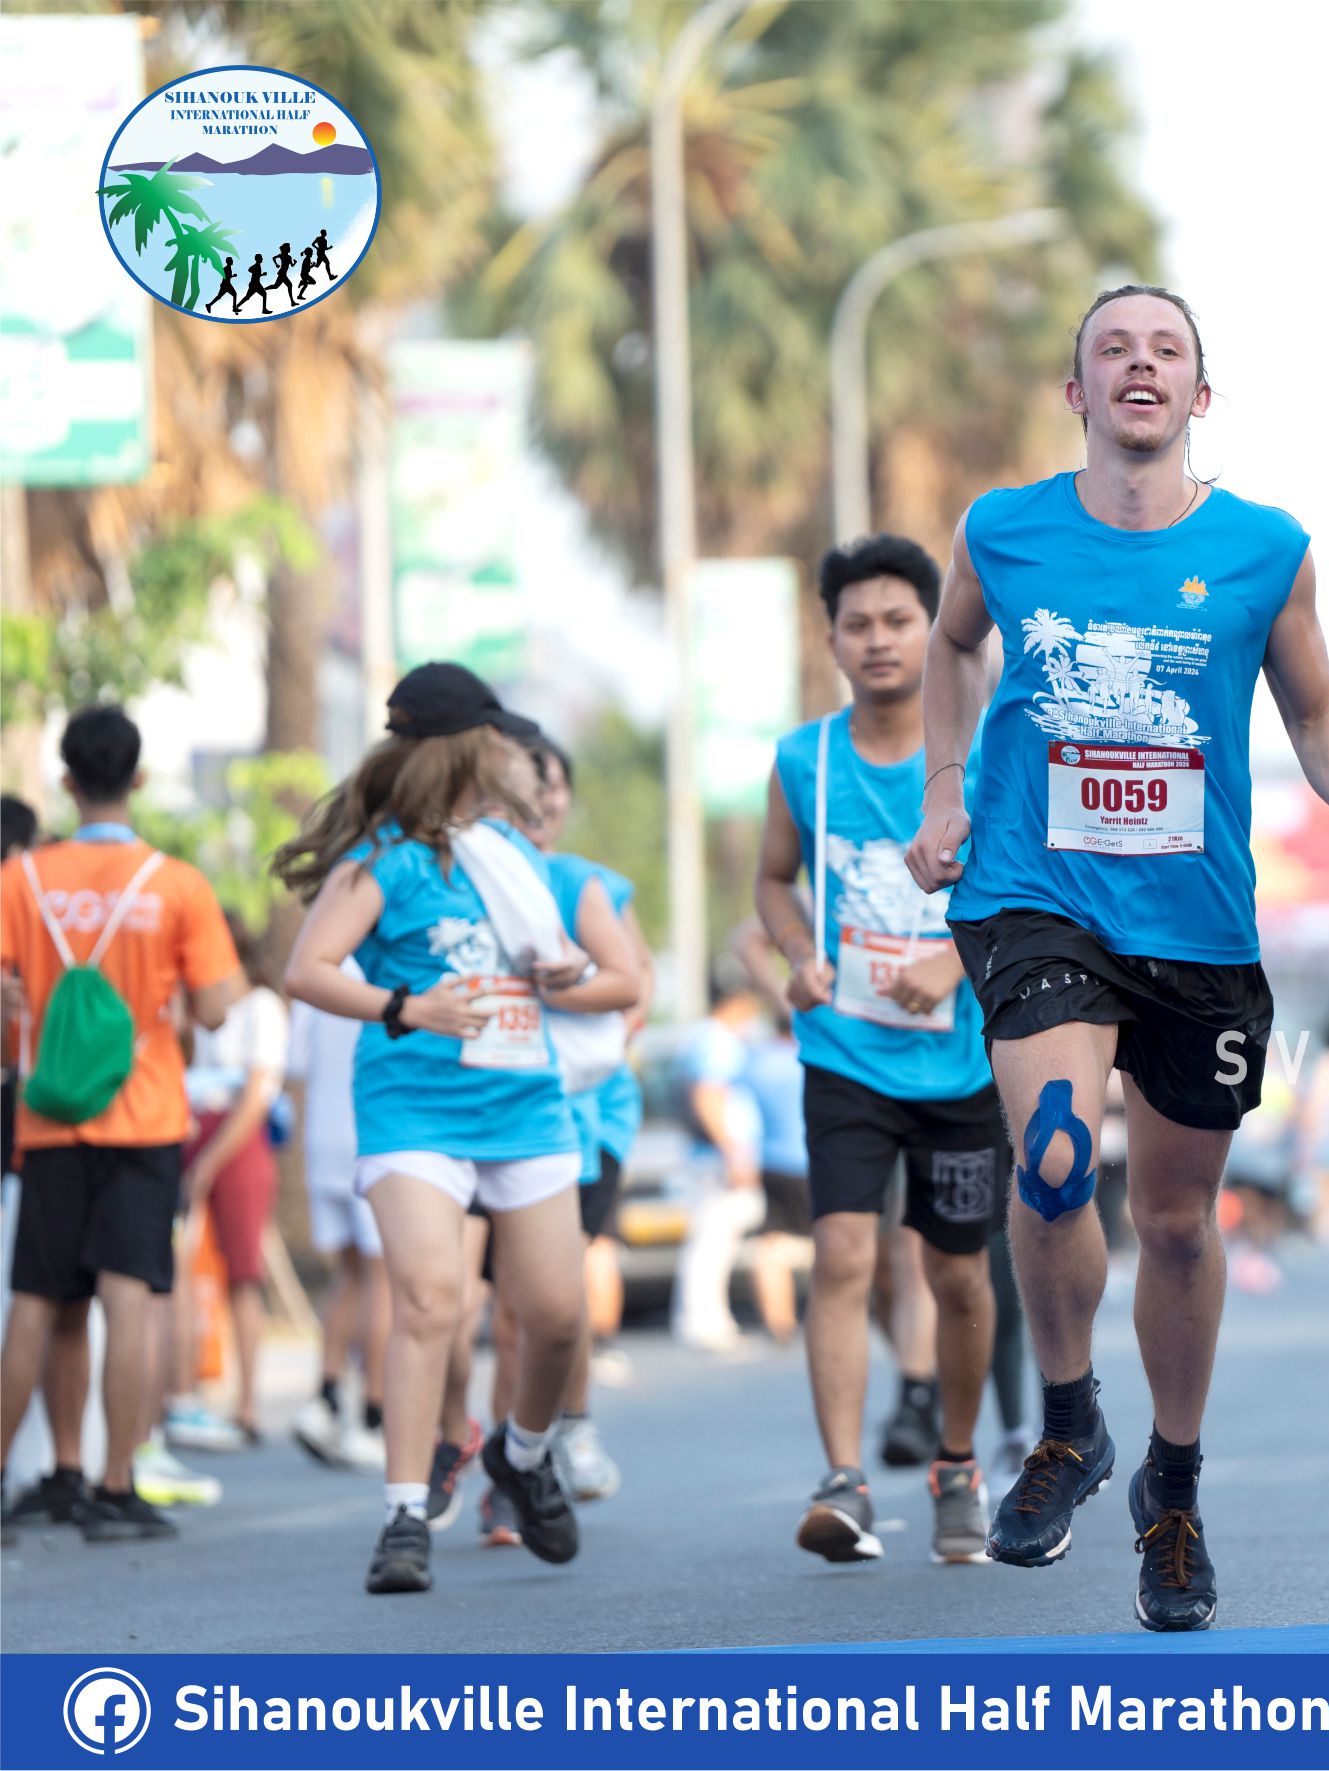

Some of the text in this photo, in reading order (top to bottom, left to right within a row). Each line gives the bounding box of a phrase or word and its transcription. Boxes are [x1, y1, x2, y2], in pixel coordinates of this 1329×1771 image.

[1166, 665, 1183, 675] April
[1183, 667, 1200, 675] 2024
[1124, 717, 1186, 735] International
[1081, 725, 1150, 743] Half Marathon
[1084, 749, 1190, 761] SIHANOUKVILLE INTERNATIONAL
[1132, 761, 1145, 769] HALF
[1146, 761, 1175, 769] MARATHON
[1081, 777, 1168, 813] 0059
[1100, 815, 1148, 826] Yarrit Heintz
